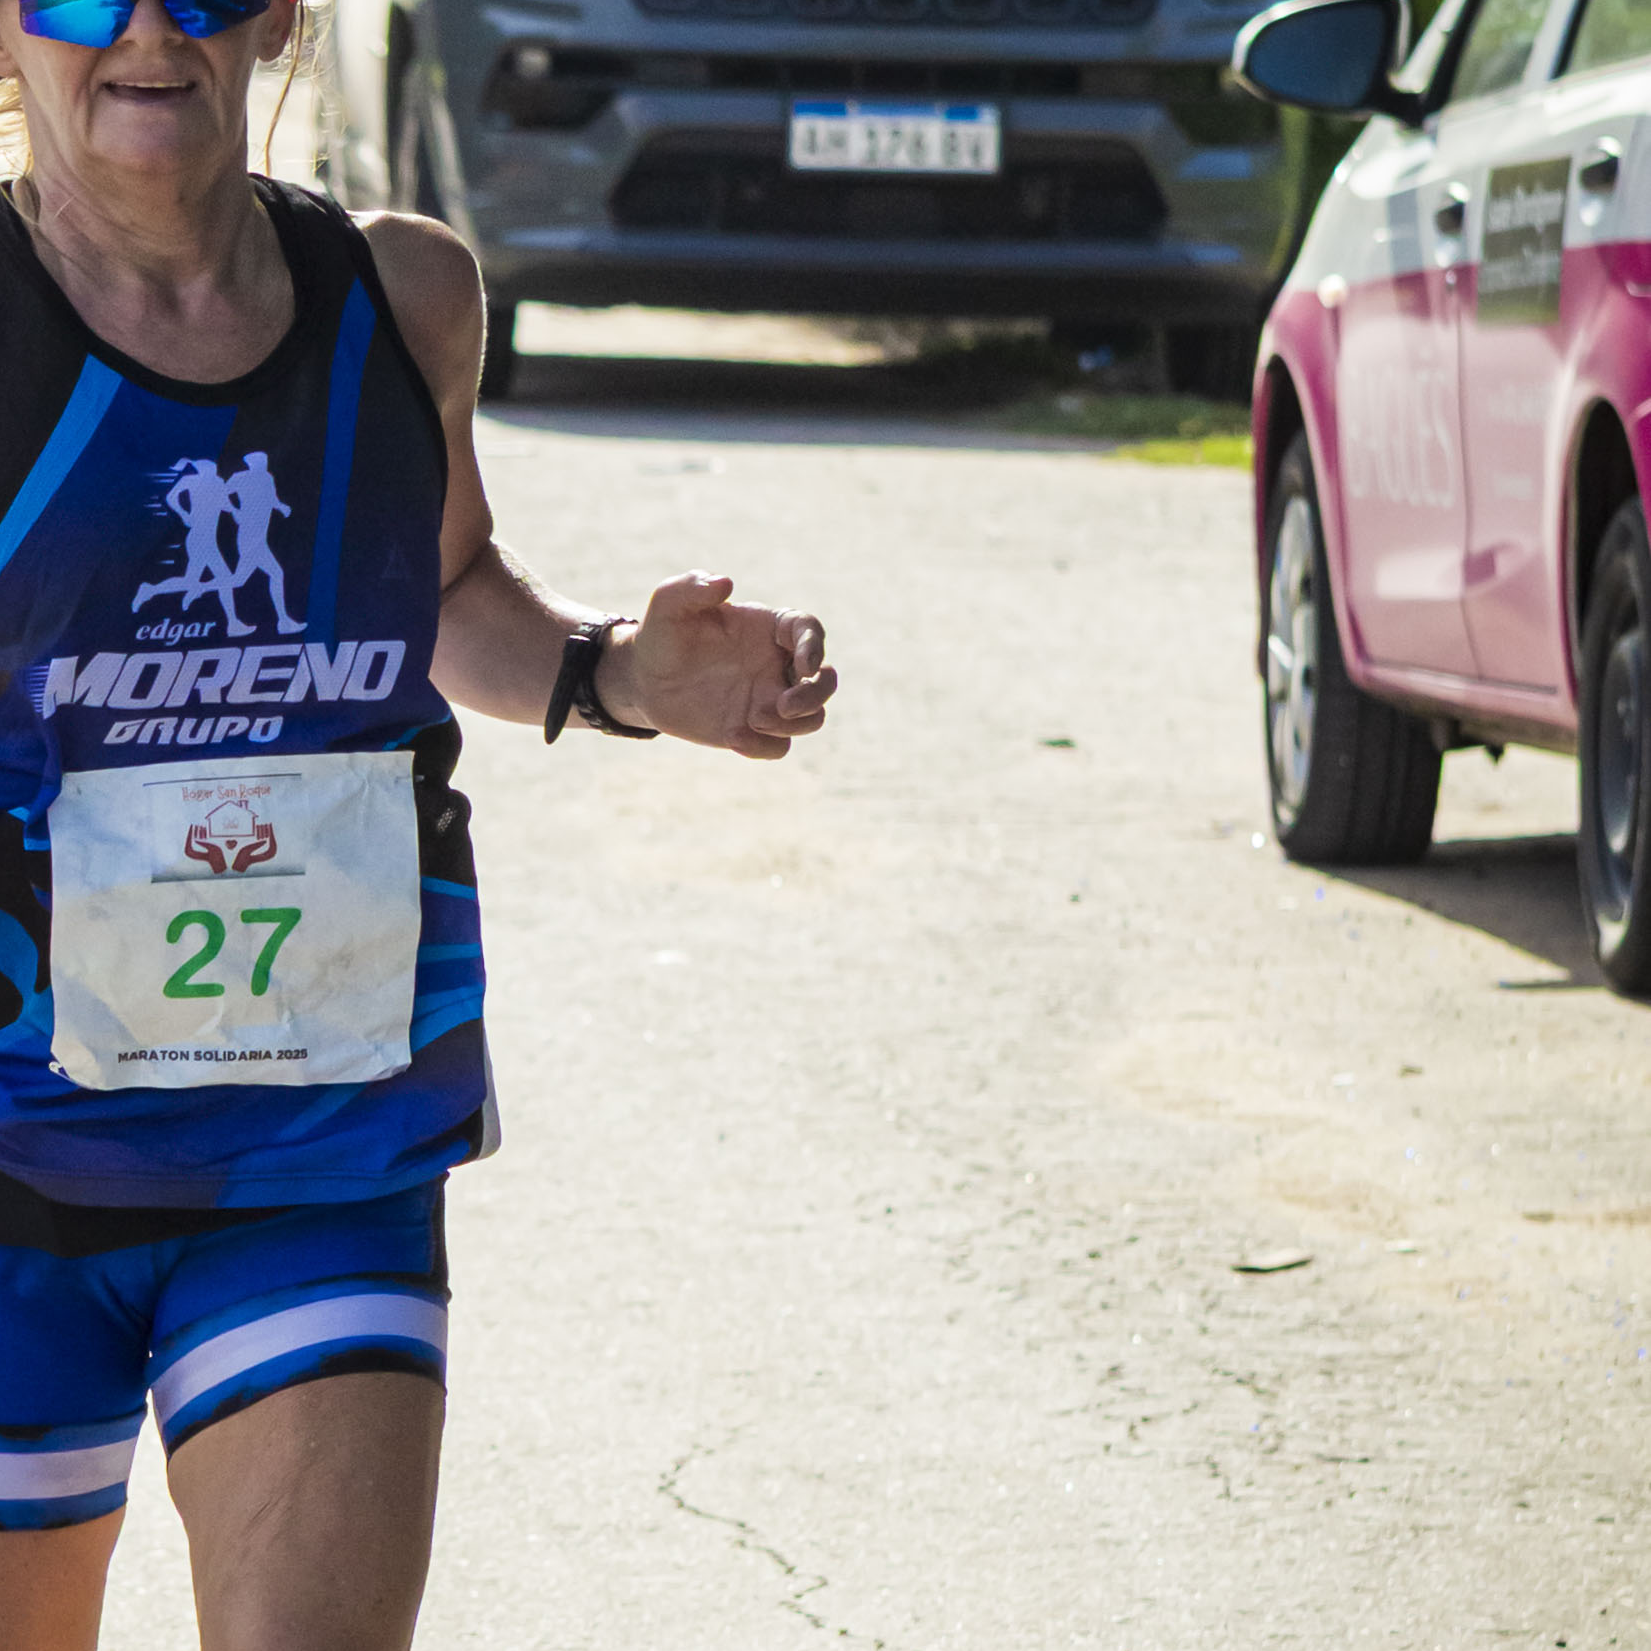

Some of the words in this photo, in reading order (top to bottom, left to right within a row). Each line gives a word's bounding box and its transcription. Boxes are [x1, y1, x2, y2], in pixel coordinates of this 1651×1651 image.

[135, 619, 217, 647] edgar
[43, 640, 406, 720] MORENO
[103, 716, 284, 745] GRUPO
[182, 786, 214, 802] Hogar
[217, 784, 237, 800] San
[238, 783, 272, 799] Roque
[163, 907, 302, 999] 27
[118, 1050, 190, 1063] MARATON
[194, 1050, 273, 1062] SOLIDARIA
[277, 1048, 309, 1060] 2025
